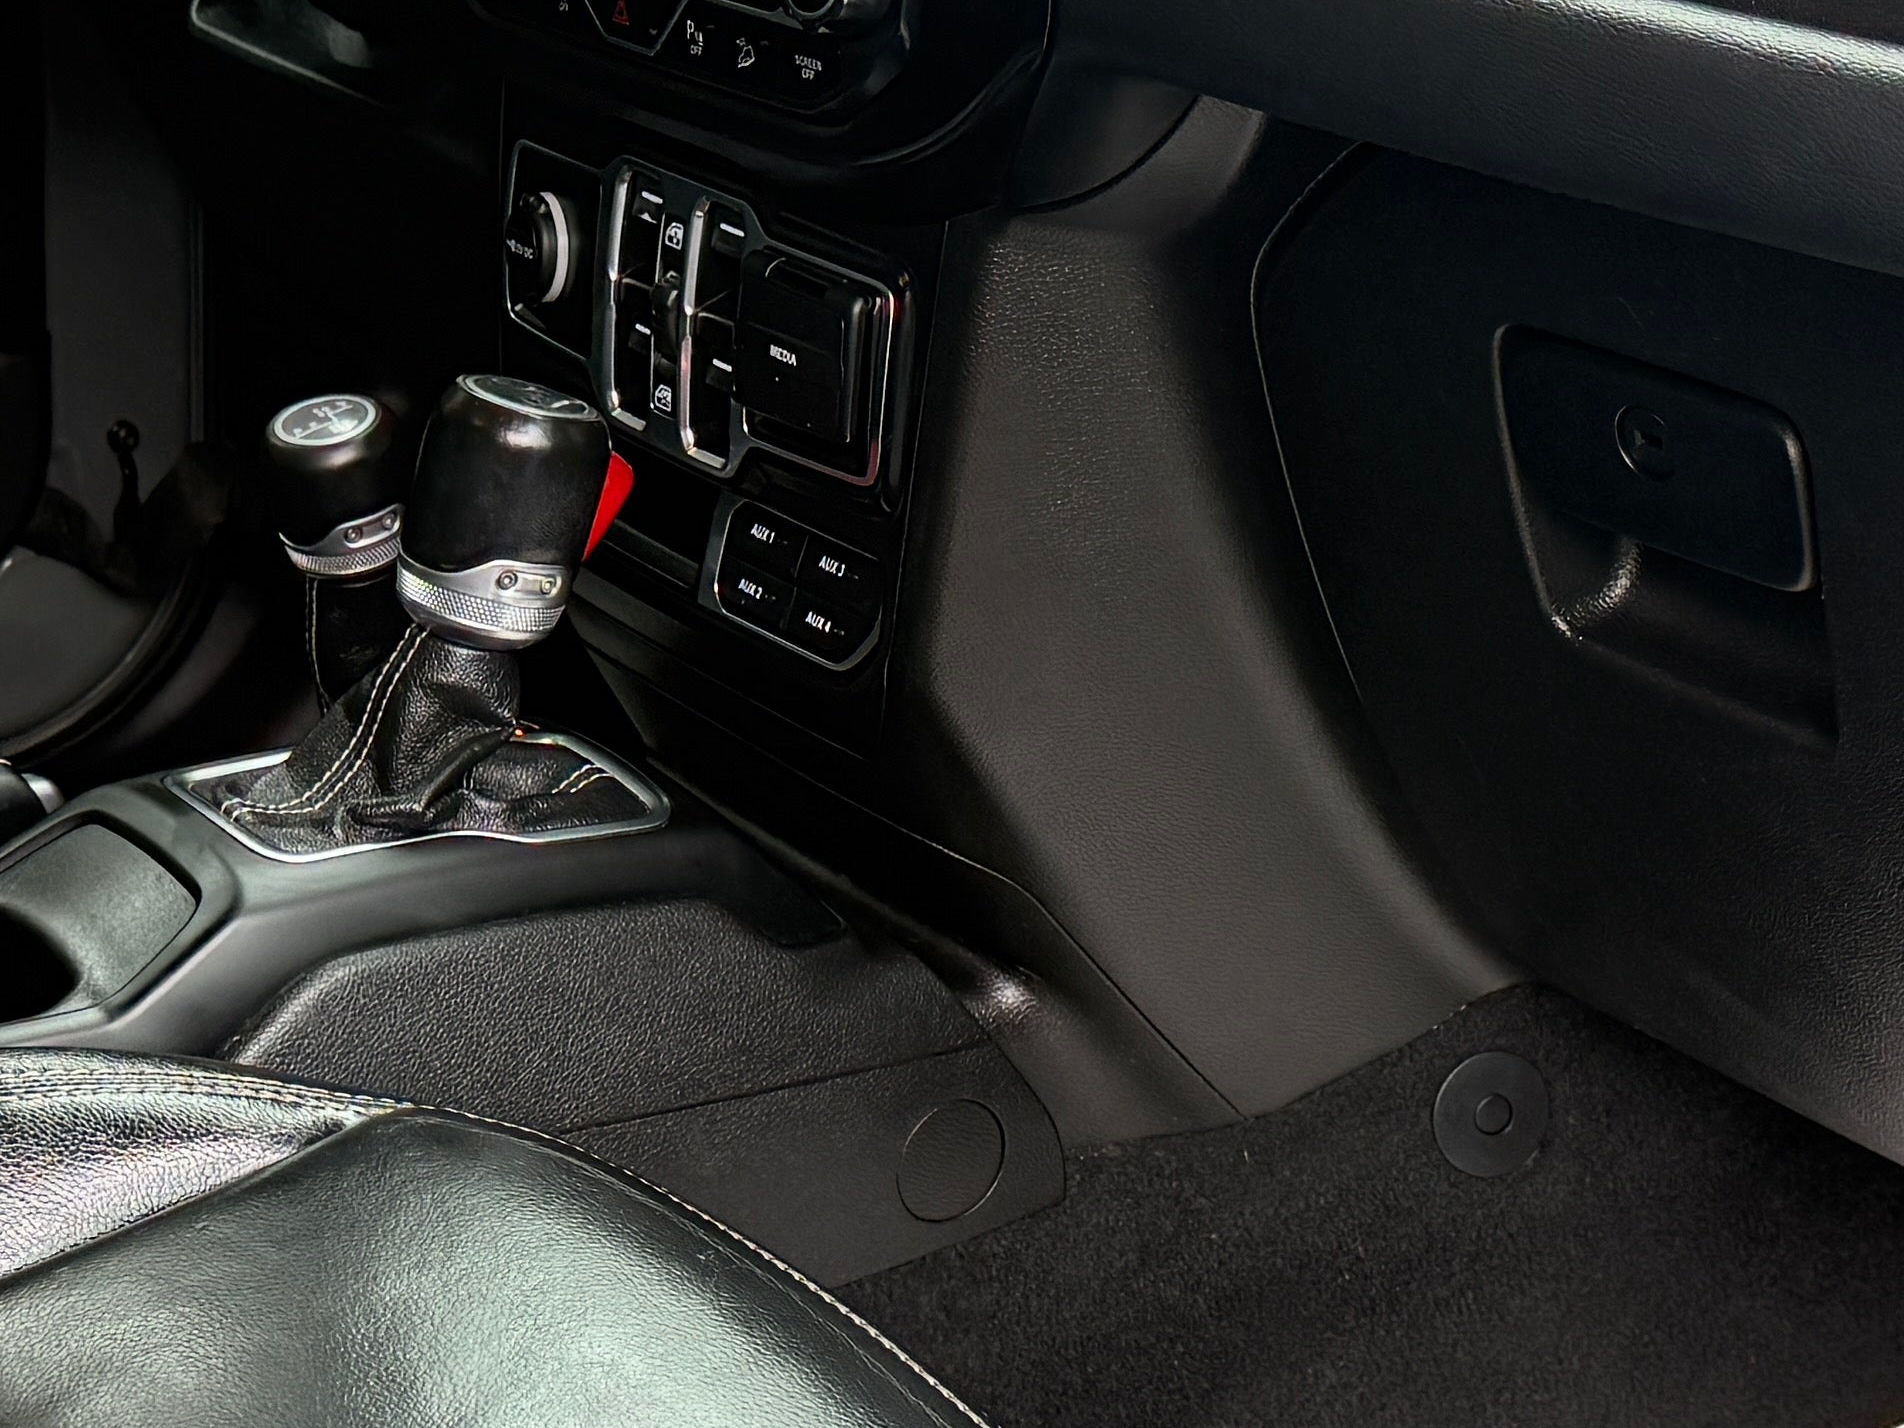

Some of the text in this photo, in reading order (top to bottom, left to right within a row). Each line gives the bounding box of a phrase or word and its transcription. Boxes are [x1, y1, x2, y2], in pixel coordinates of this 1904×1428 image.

[750, 523, 775, 544] AUX 1
[818, 555, 840, 574] AUX
[738, 578, 763, 600] AUX 2
[805, 611, 825, 630] AUX
